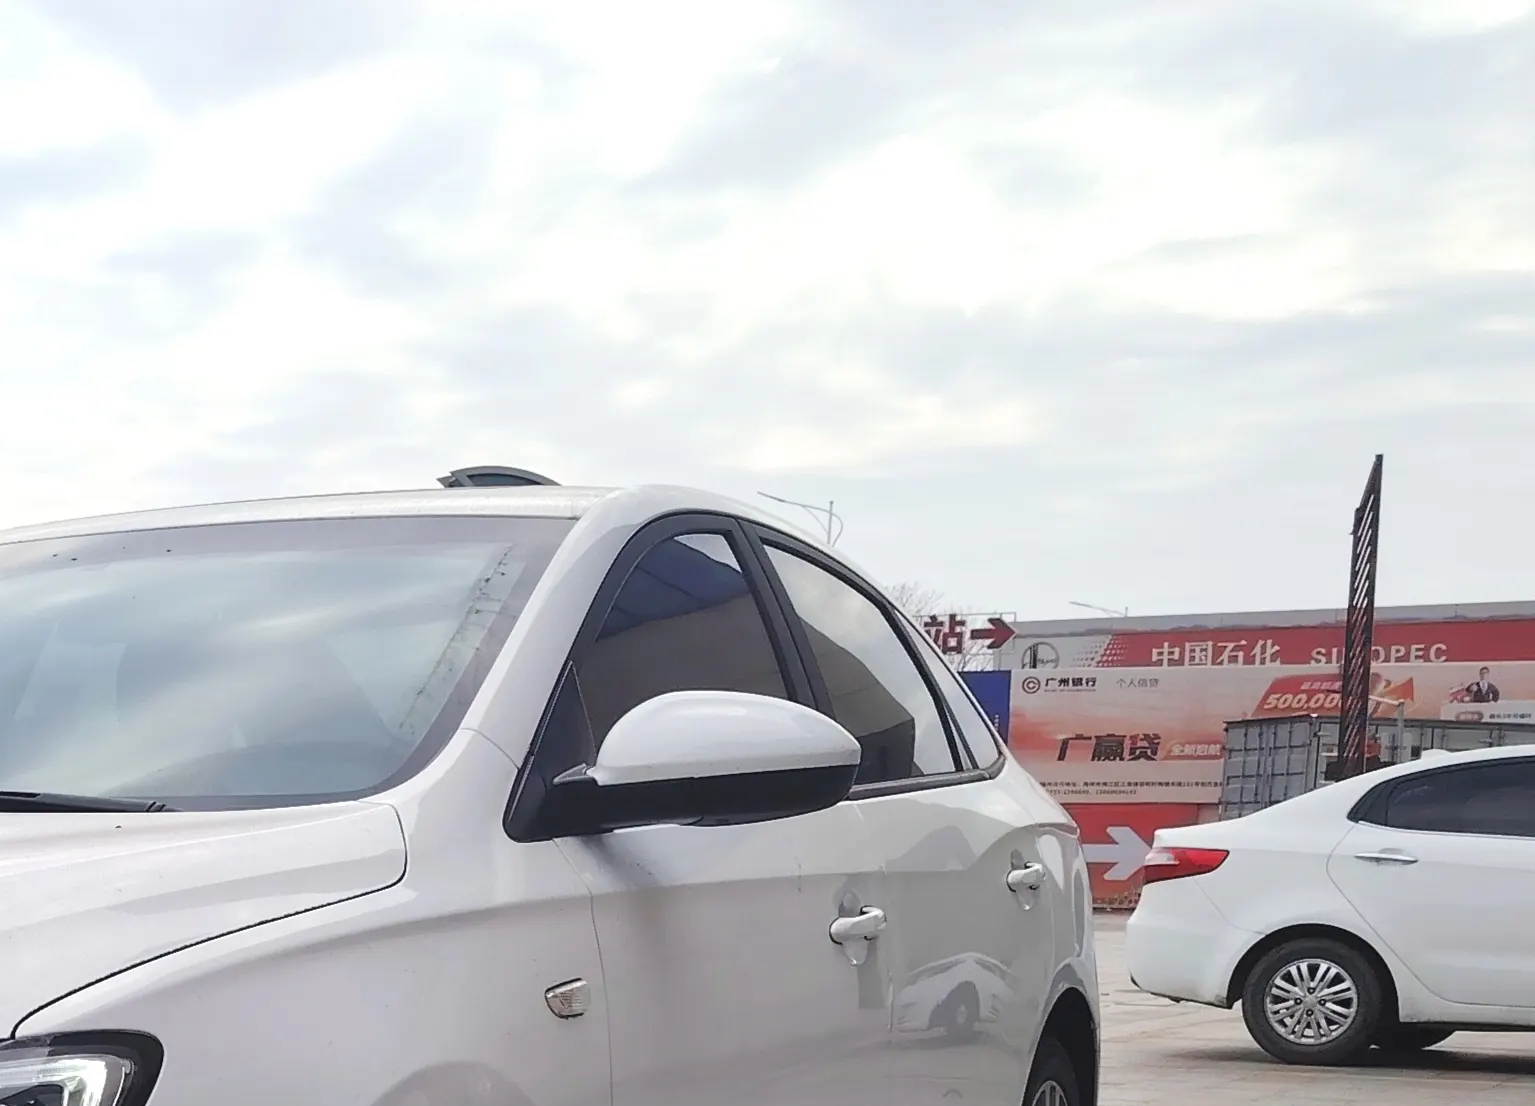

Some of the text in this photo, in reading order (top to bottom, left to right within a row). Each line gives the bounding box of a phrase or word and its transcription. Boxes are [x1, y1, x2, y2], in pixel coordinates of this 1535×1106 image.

[924, 614, 966, 655] 站
[1151, 640, 1448, 668] 中国石化 SIOPEC
[1045, 678, 1097, 688] 广州银行
[1116, 678, 1160, 689] 个人信贷
[1057, 733, 1161, 762] 广赢贷
